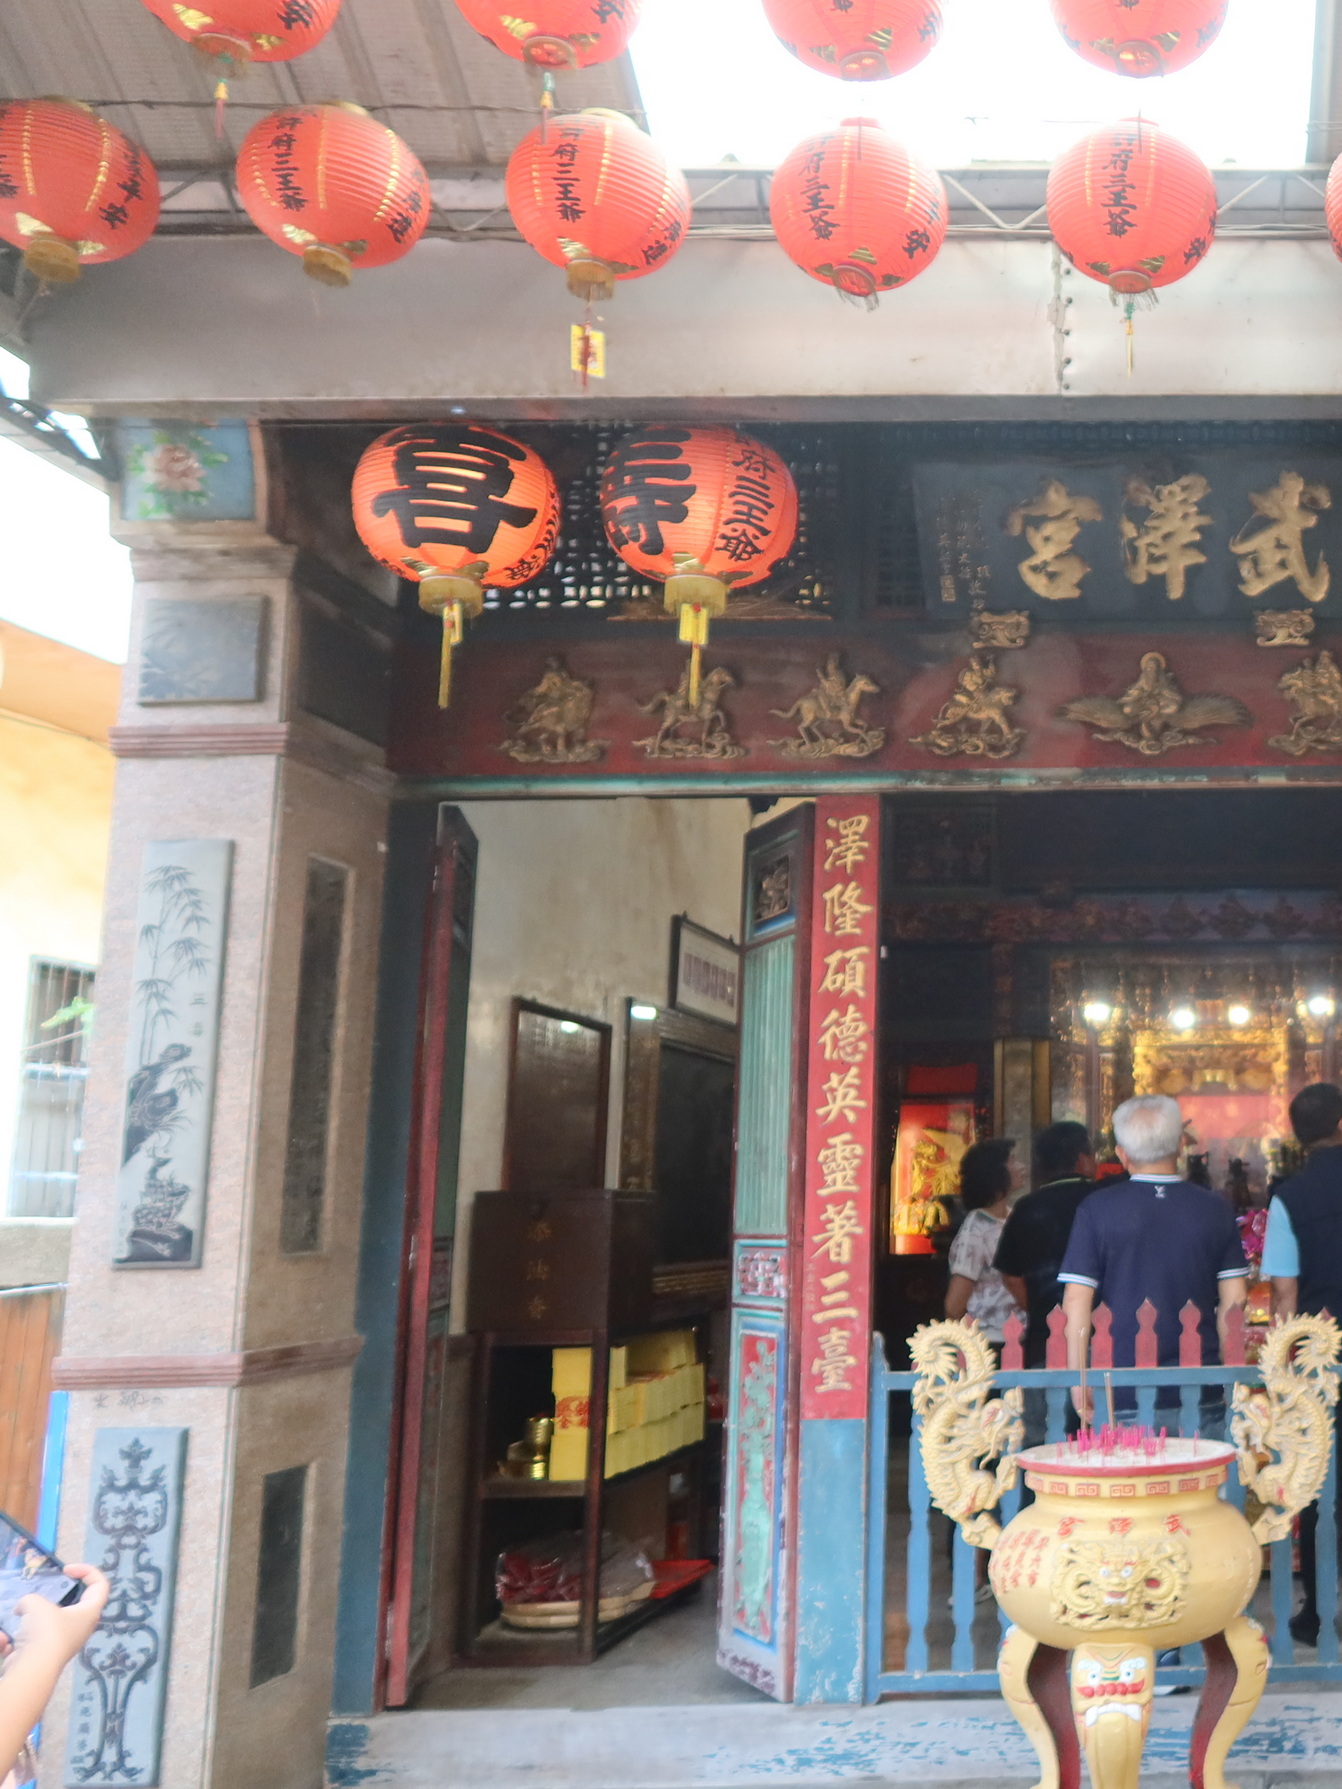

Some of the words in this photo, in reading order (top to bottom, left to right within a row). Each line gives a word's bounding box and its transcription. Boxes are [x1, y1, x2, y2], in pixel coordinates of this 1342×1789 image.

[715, 437, 776, 562] 府三王爺
[1002, 470, 1332, 602] 武澤宮
